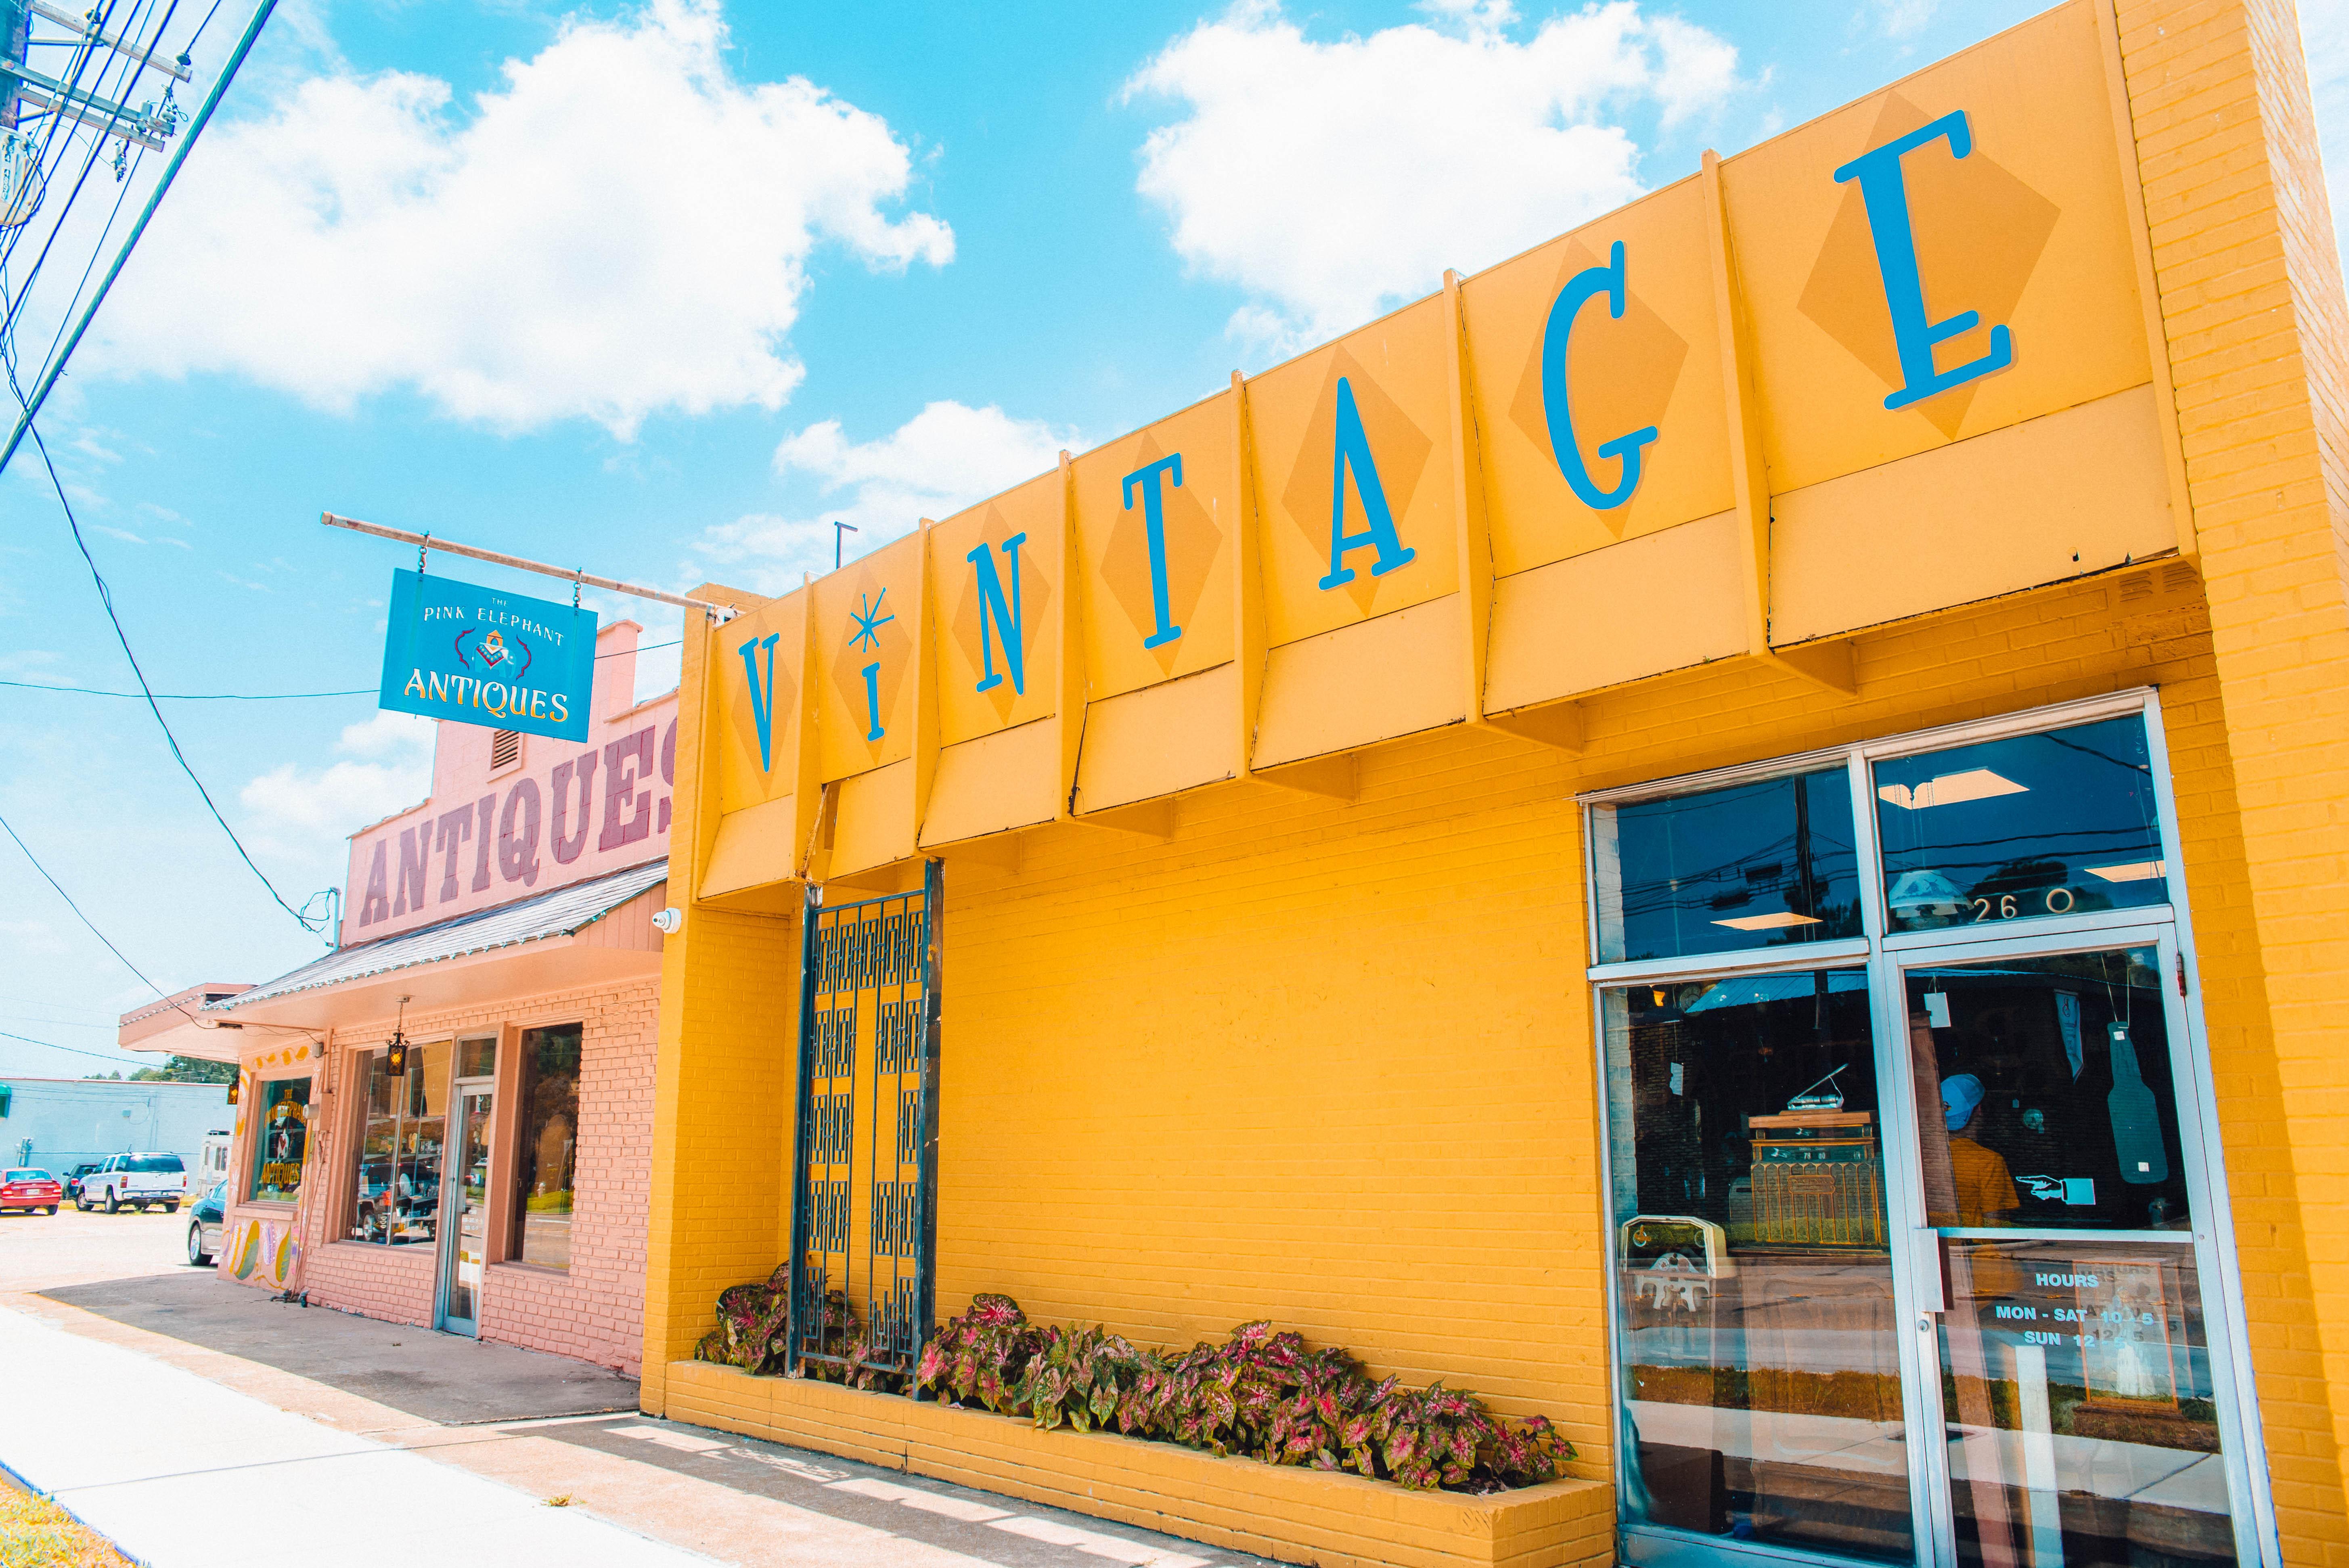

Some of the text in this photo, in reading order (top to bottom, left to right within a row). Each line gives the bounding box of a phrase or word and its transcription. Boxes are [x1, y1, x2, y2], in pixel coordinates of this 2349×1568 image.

[491, 597, 509, 607] THE
[424, 606, 564, 647] PINK ELEPHANT
[404, 668, 568, 722] ANTIQUES
[284, 1089, 293, 1099] THE
[262, 1162, 301, 1189] ANTIQUES
[2035, 1273, 2099, 1288] HOURS
[1995, 1306, 2037, 1320] MON
[2054, 1308, 2087, 1322] SAT
[2101, 1311, 2123, 1324] 10
[2142, 1313, 2155, 1326] 5
[2024, 1331, 2061, 1346] SUN
[2073, 1334, 2096, 1348] 12
[2114, 1337, 2126, 1349] 5
